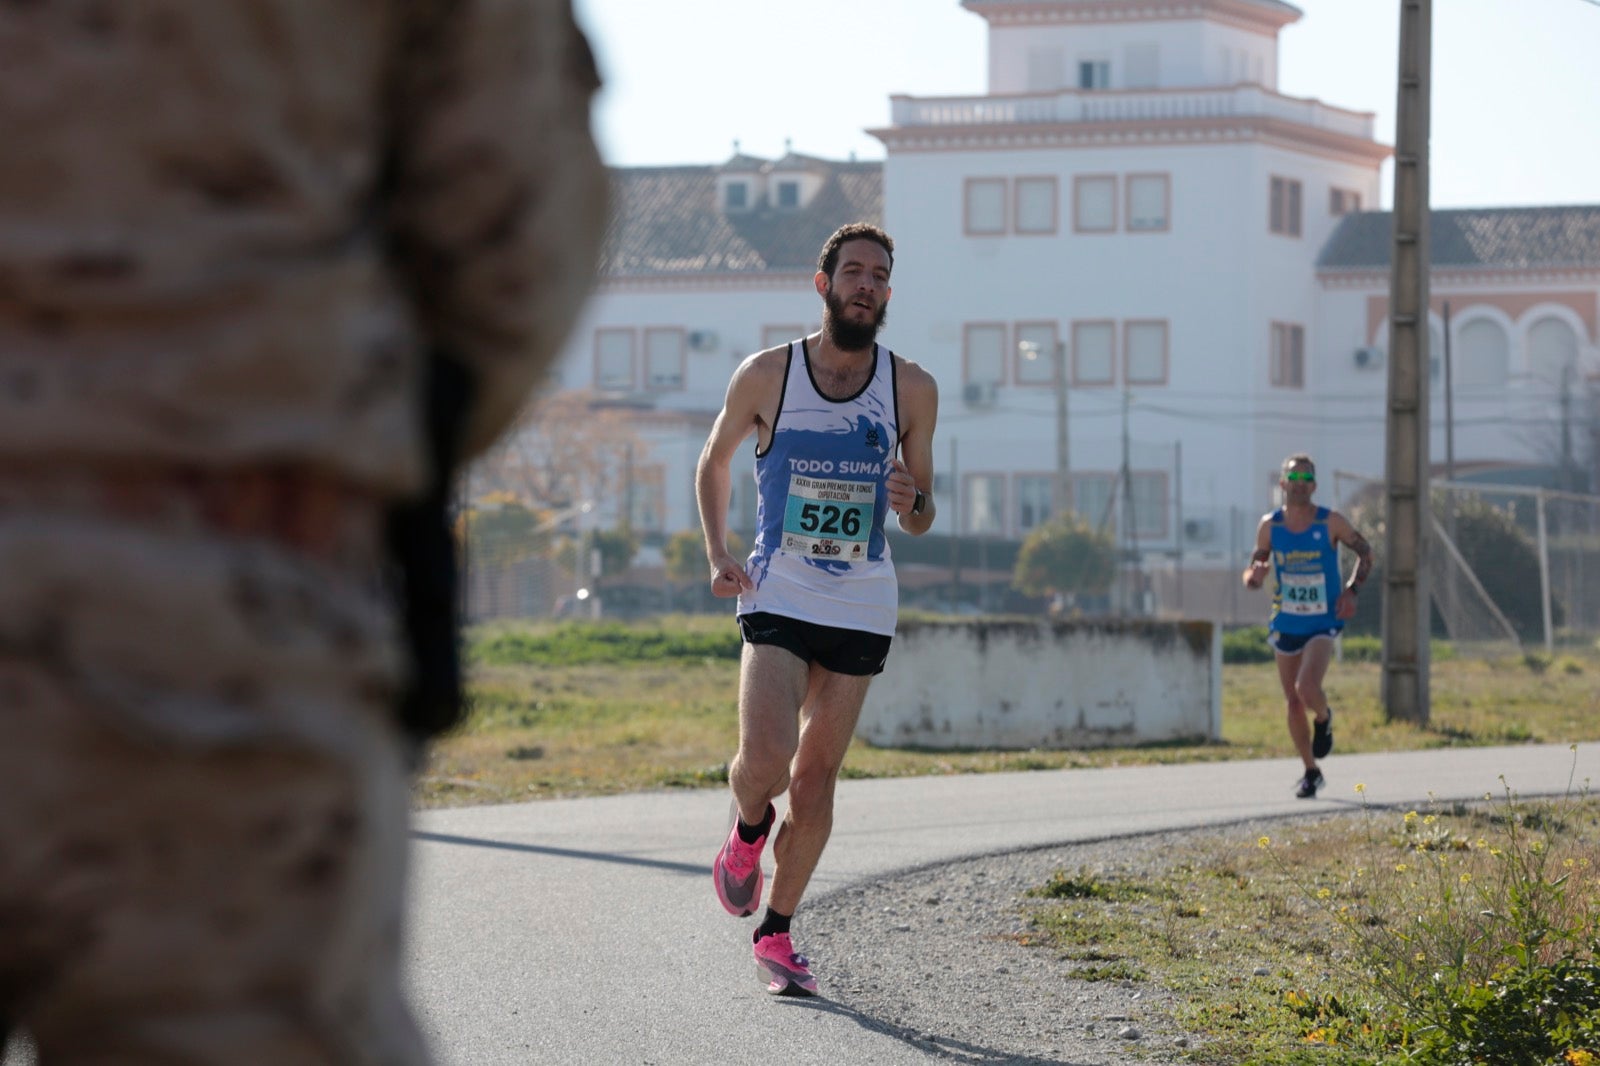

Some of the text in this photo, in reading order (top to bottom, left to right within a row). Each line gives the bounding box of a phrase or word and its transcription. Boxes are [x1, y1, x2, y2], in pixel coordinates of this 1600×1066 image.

[788, 458, 881, 474] TODO SUMA
[800, 503, 861, 536] 526
[1288, 587, 1319, 602] 428
